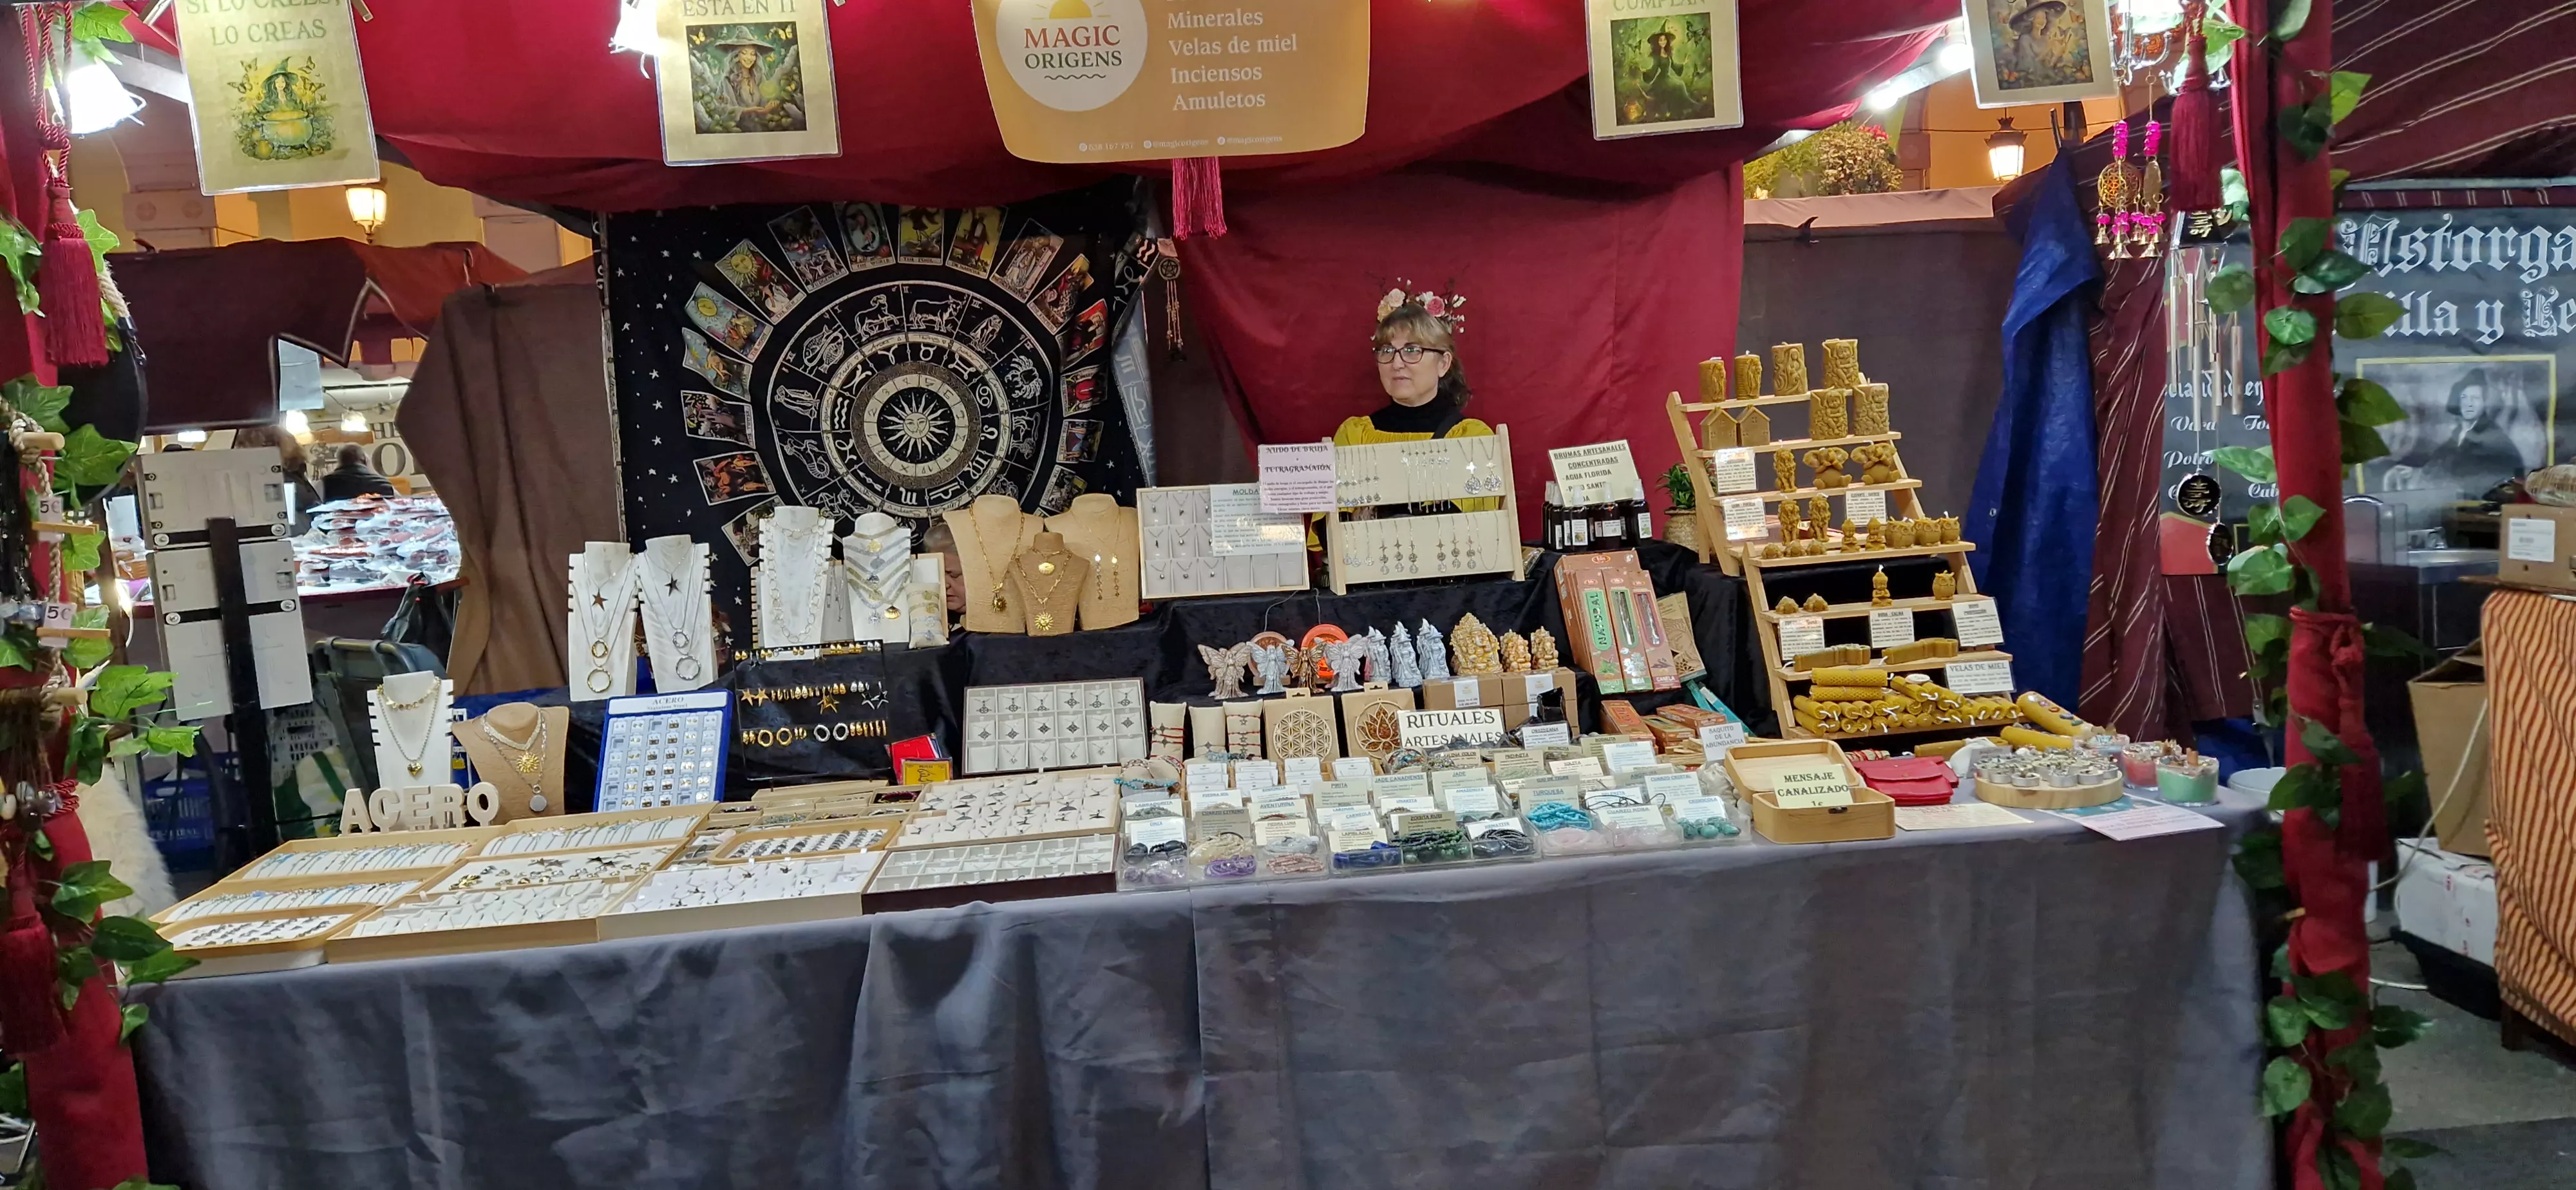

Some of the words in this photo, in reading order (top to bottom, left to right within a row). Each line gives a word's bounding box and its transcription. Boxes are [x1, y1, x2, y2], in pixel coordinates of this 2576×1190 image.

[1168, 9, 1264, 29] Minerales
[211, 25, 239, 46] LO
[248, 19, 327, 42] CREAS
[1024, 25, 1121, 50] MAGIC
[1168, 39, 1221, 56] Velas
[1227, 37, 1250, 53] de
[1256, 33, 1298, 53] miel
[1024, 51, 1122, 70] ORIGENS
[1170, 65, 1263, 84] Inciensos
[1173, 90, 1265, 111] Amuletos
[2476, 298, 2504, 345] y
[1302, 445, 1329, 453] BRUJA
[1553, 449, 1582, 460] BRUMAS
[1583, 444, 1627, 456] ARTESANALES
[1567, 456, 1619, 470] CONCENTRADAS
[1584, 469, 1613, 478] FLORIDA
[1950, 664, 1973, 672] VELAS
[652, 697, 684, 705] ACERO
[1406, 711, 1495, 728] RITUALES
[1405, 731, 1502, 748] ARTESANALES
[1705, 739, 1744, 748] ABUNDANCIA
[1784, 771, 1835, 783] MENSAJE
[1777, 784, 1849, 797] CANALIZADO
[338, 780, 500, 836] ACERO
